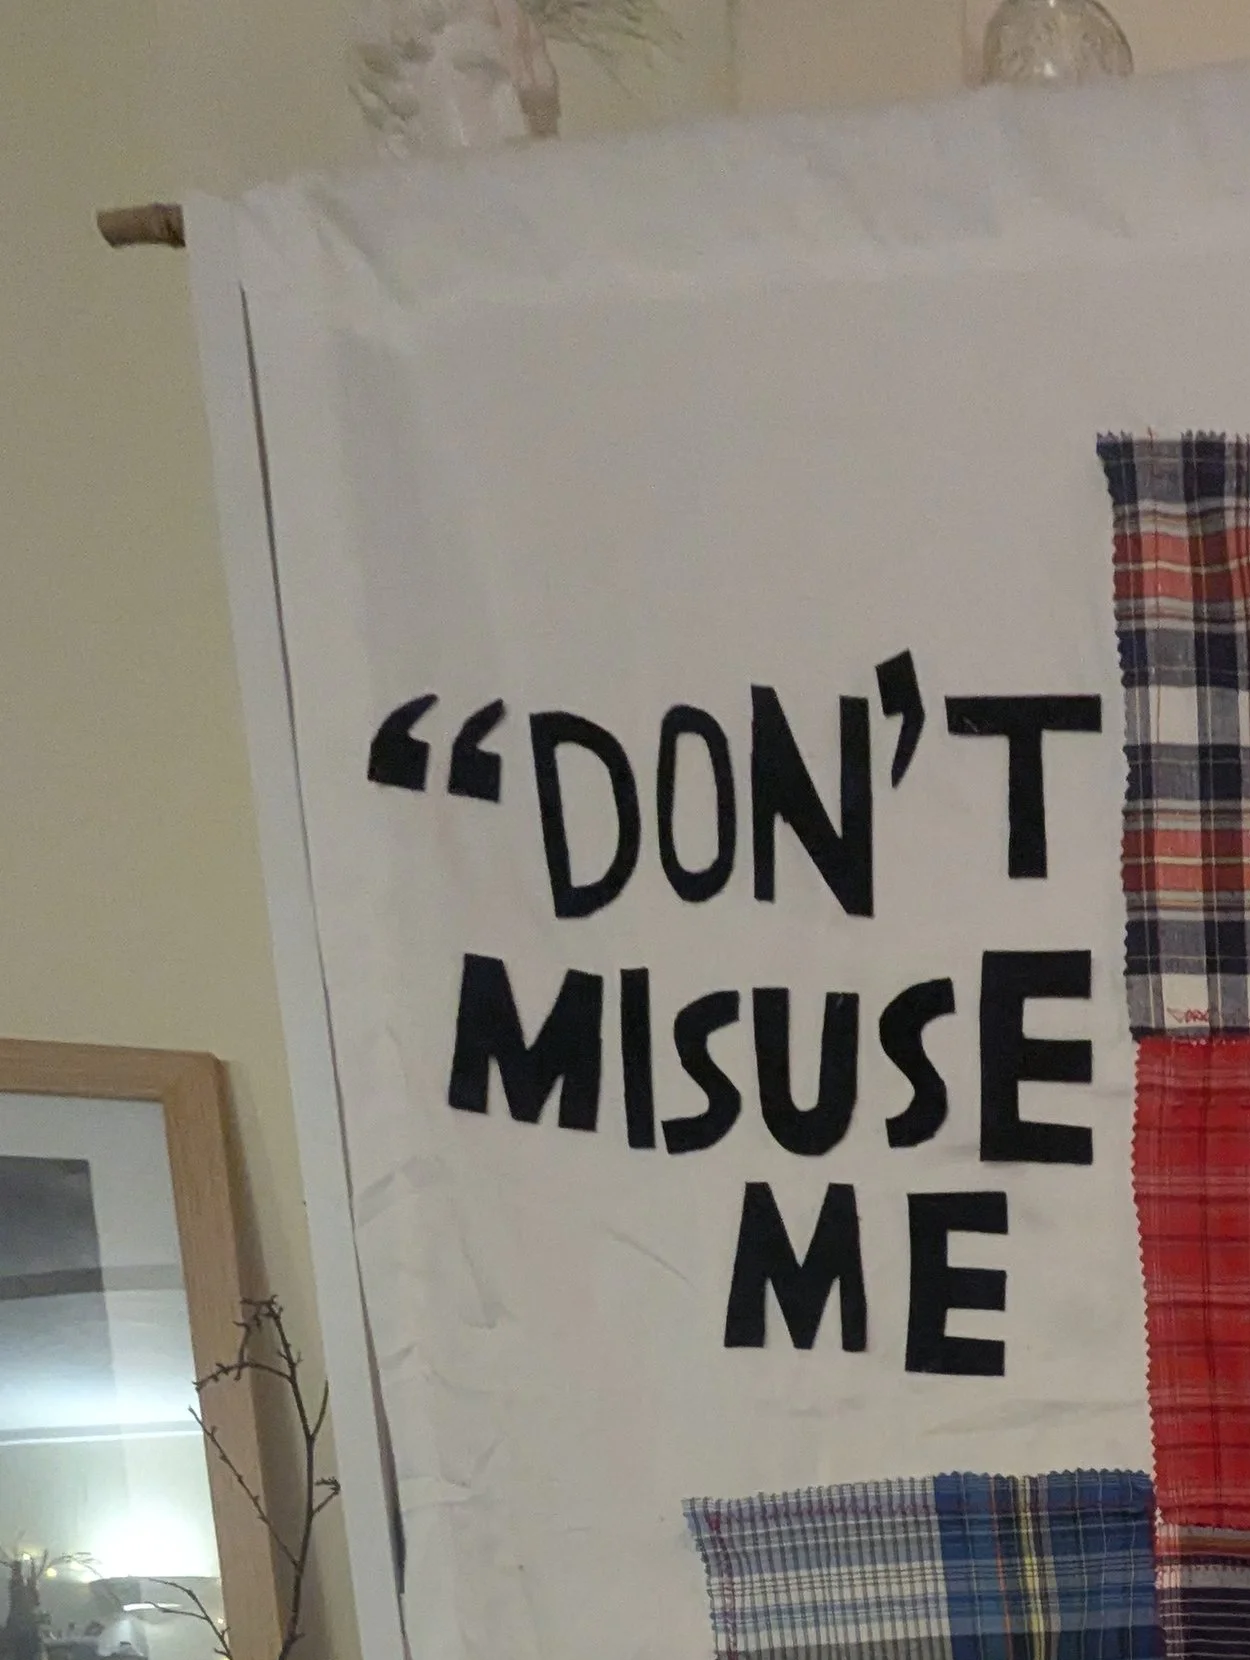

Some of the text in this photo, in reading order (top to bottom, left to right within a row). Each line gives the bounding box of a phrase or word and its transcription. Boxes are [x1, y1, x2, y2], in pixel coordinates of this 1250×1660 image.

[368, 649, 1102, 919] “DON’T
[449, 949, 1094, 1165] MISUSE
[724, 1181, 1009, 1376] ME
